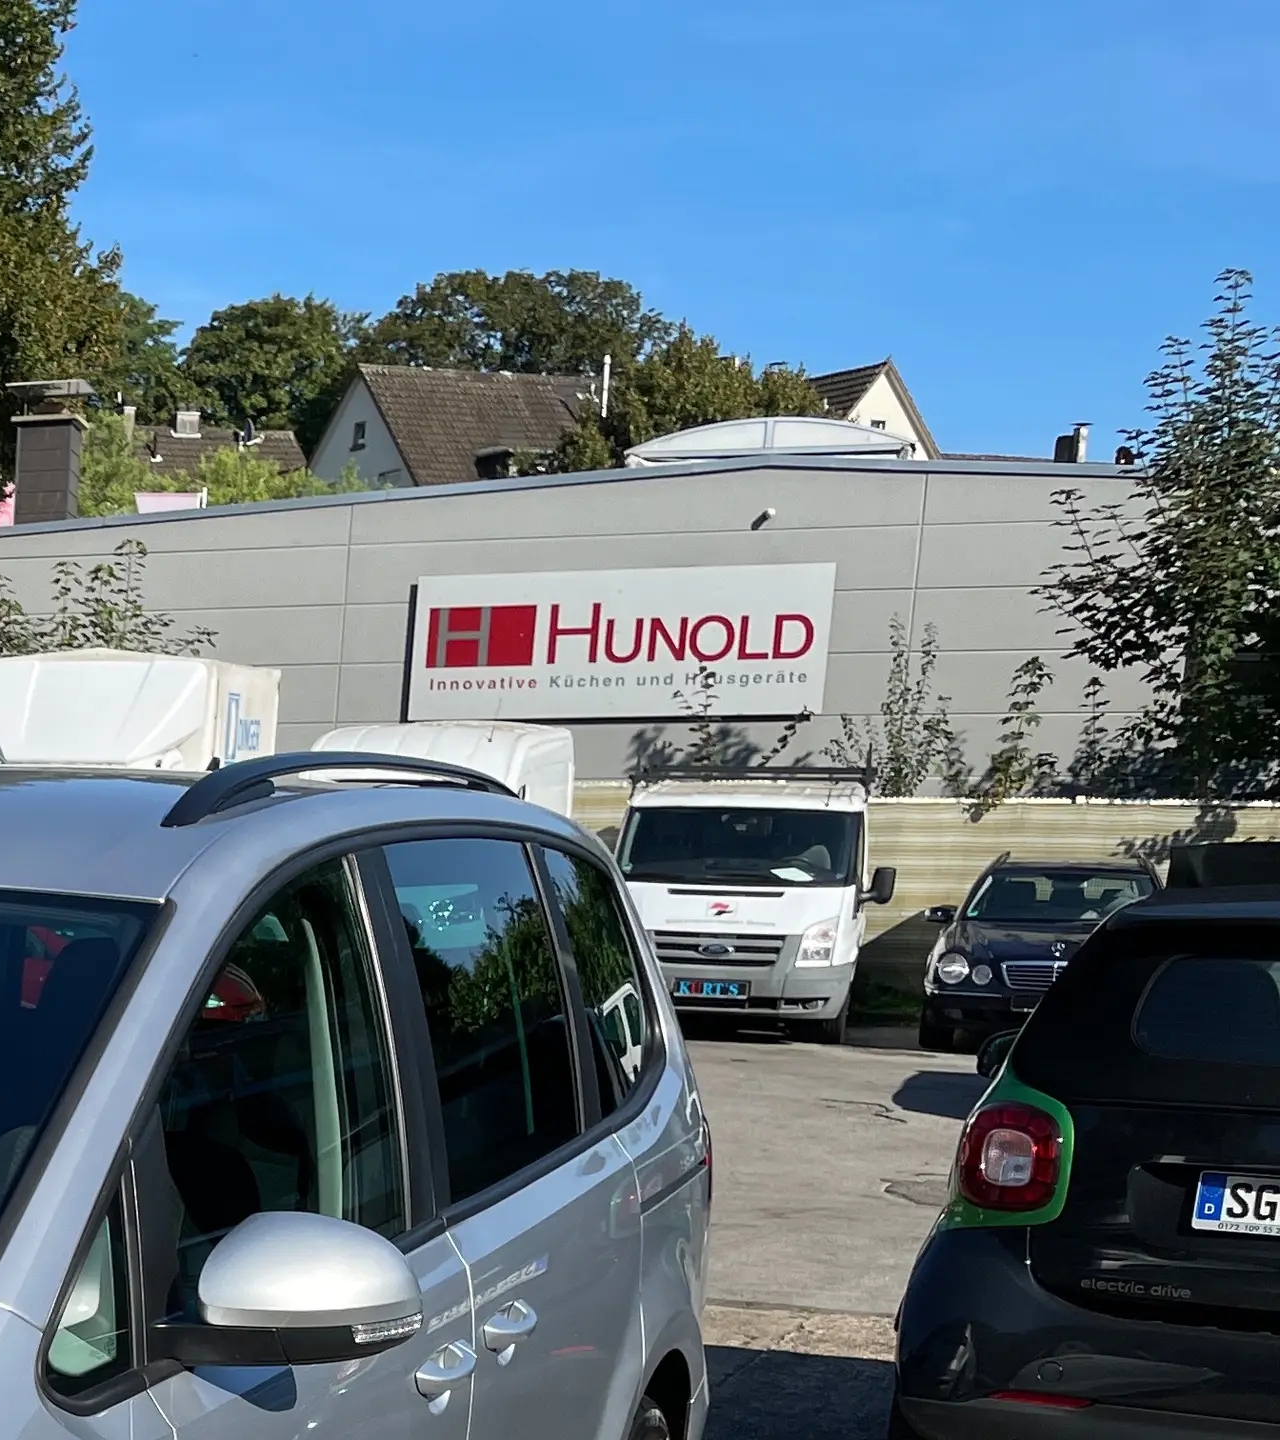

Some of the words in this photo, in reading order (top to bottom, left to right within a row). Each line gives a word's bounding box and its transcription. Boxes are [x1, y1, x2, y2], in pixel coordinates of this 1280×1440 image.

[546, 602, 815, 665] HUNOLD
[429, 676, 538, 691] Innovative
[549, 674, 626, 689] Küchen
[636, 672, 674, 687] und
[679, 980, 740, 997] KURT'S
[1203, 1202, 1216, 1215] D
[1217, 1222, 1240, 1231] 0172
[1080, 1278, 1145, 1294] electric
[1150, 1285, 1192, 1299] drive
